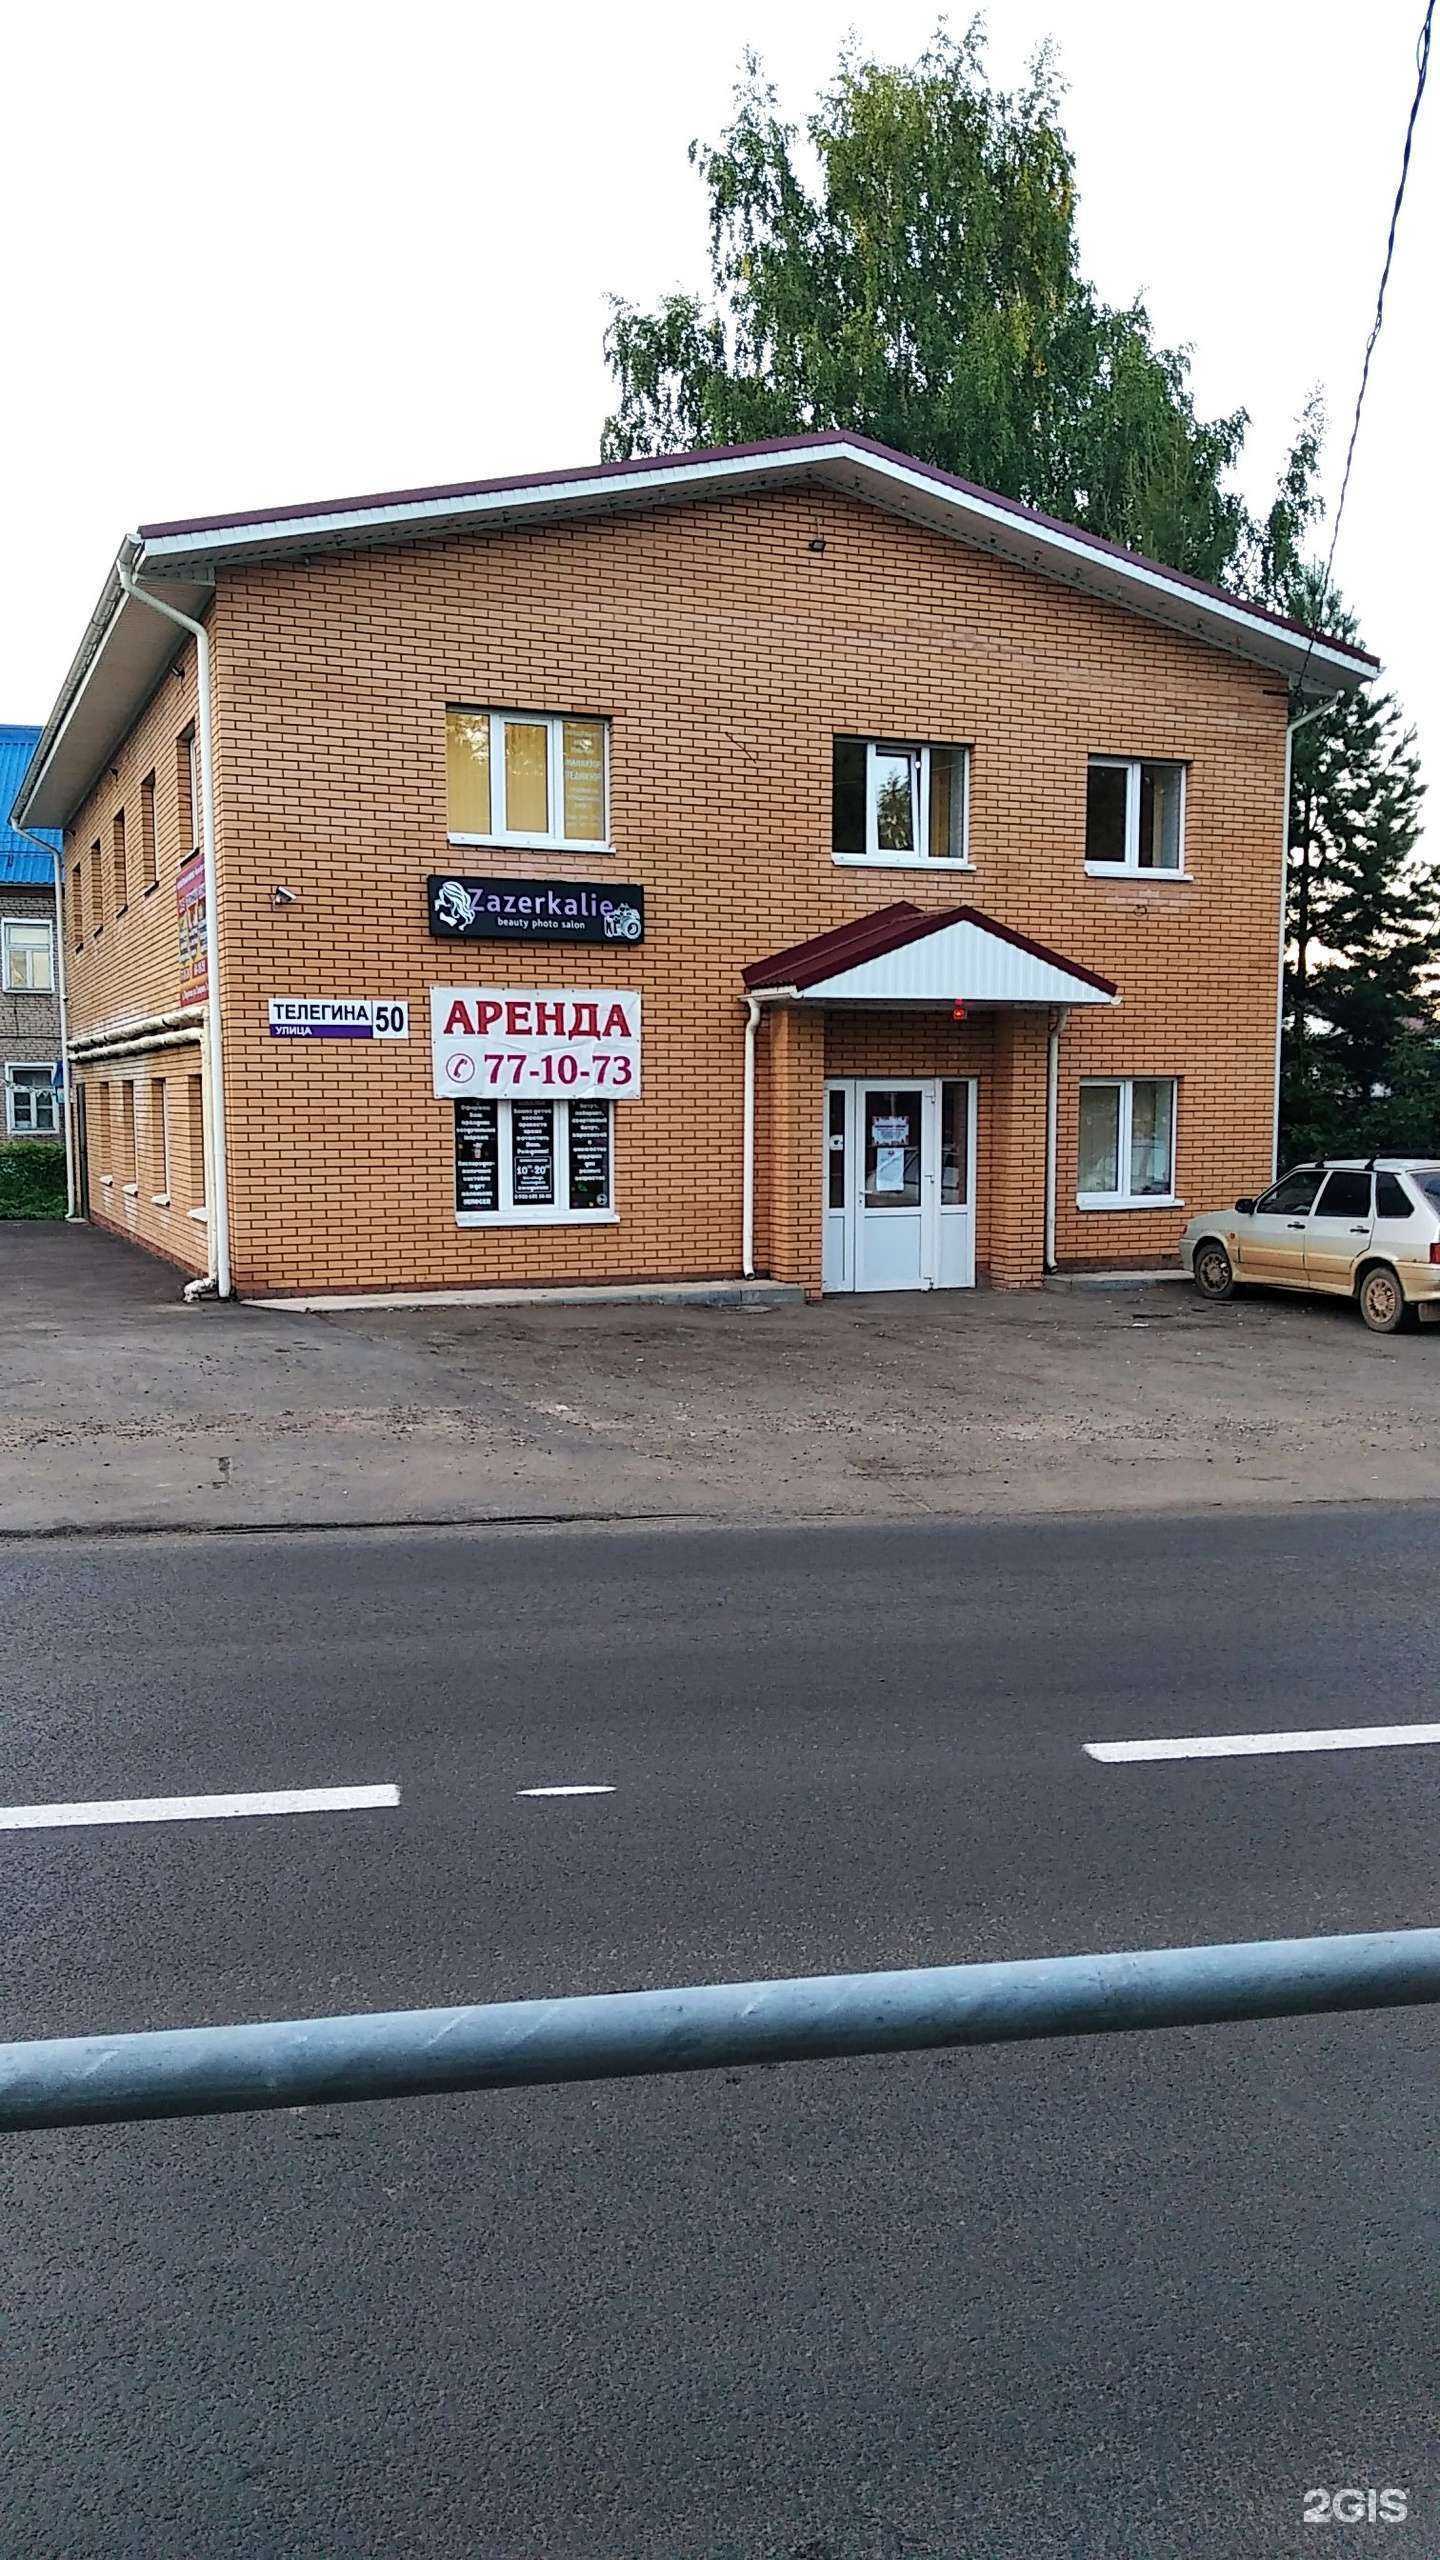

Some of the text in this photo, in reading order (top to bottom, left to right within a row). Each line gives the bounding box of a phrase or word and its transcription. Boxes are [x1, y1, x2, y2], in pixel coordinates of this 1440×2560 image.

[467, 888, 613, 917] Zazerkalie
[497, 917, 586, 930] beauty photo salon
[273, 1003, 369, 1021] ТЕЛЕГИНА
[375, 1006, 404, 1032] 50
[443, 1000, 632, 1041] АРЕНДА
[275, 1025, 313, 1036] УЛИЦА
[484, 1054, 632, 1086] 77-10-73
